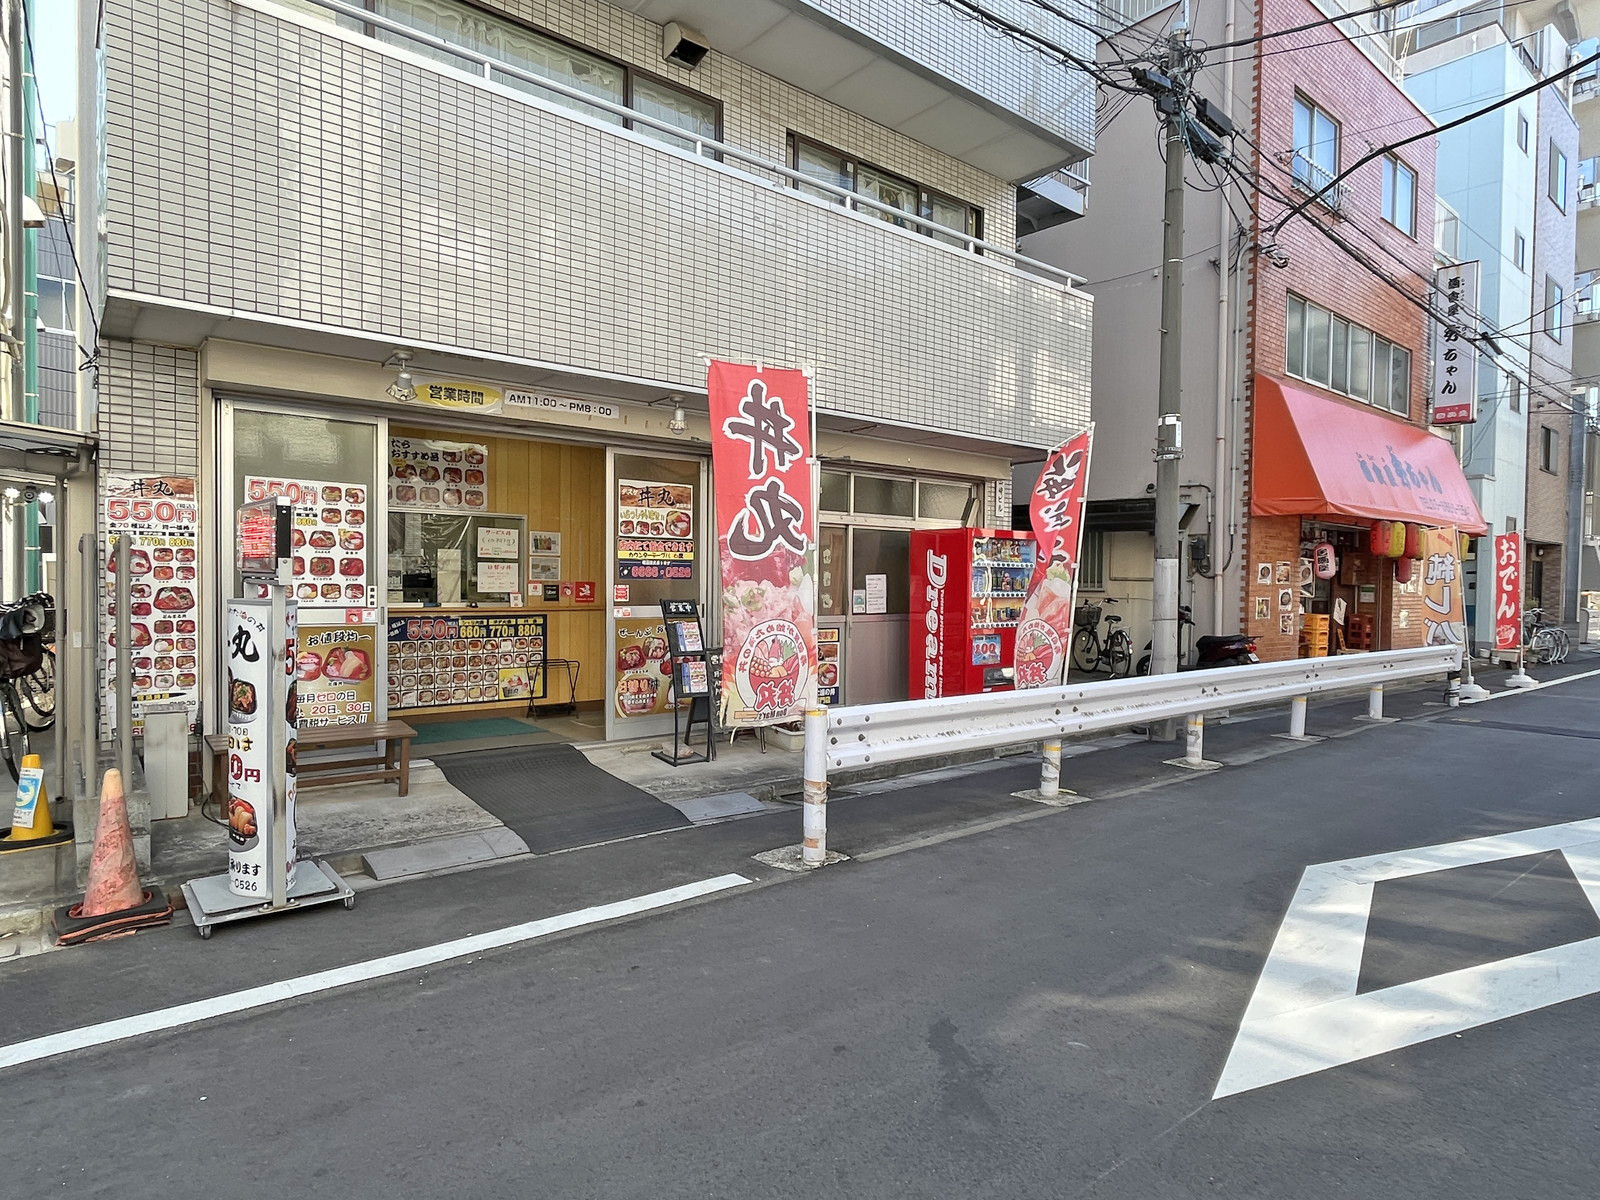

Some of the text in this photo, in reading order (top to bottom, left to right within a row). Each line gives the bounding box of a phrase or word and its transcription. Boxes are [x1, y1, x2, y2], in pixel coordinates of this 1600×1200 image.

[429, 384, 484, 406] 営業時間
[391, 449, 440, 462] おすすめ品
[129, 479, 175, 497] 丼丸
[638, 486, 676, 508] 丼丸
[108, 499, 197, 523] 550円
[1497, 538, 1518, 620] おでん
[407, 619, 459, 640] 550円
[460, 626, 486, 639] 660円
[489, 625, 515, 638] 770円
[518, 624, 543, 637] 880円
[618, 628, 653, 639] ぜーんぶ
[925, 549, 948, 700] Dream
[228, 625, 260, 663] 丸
[307, 630, 372, 646] お値段均一
